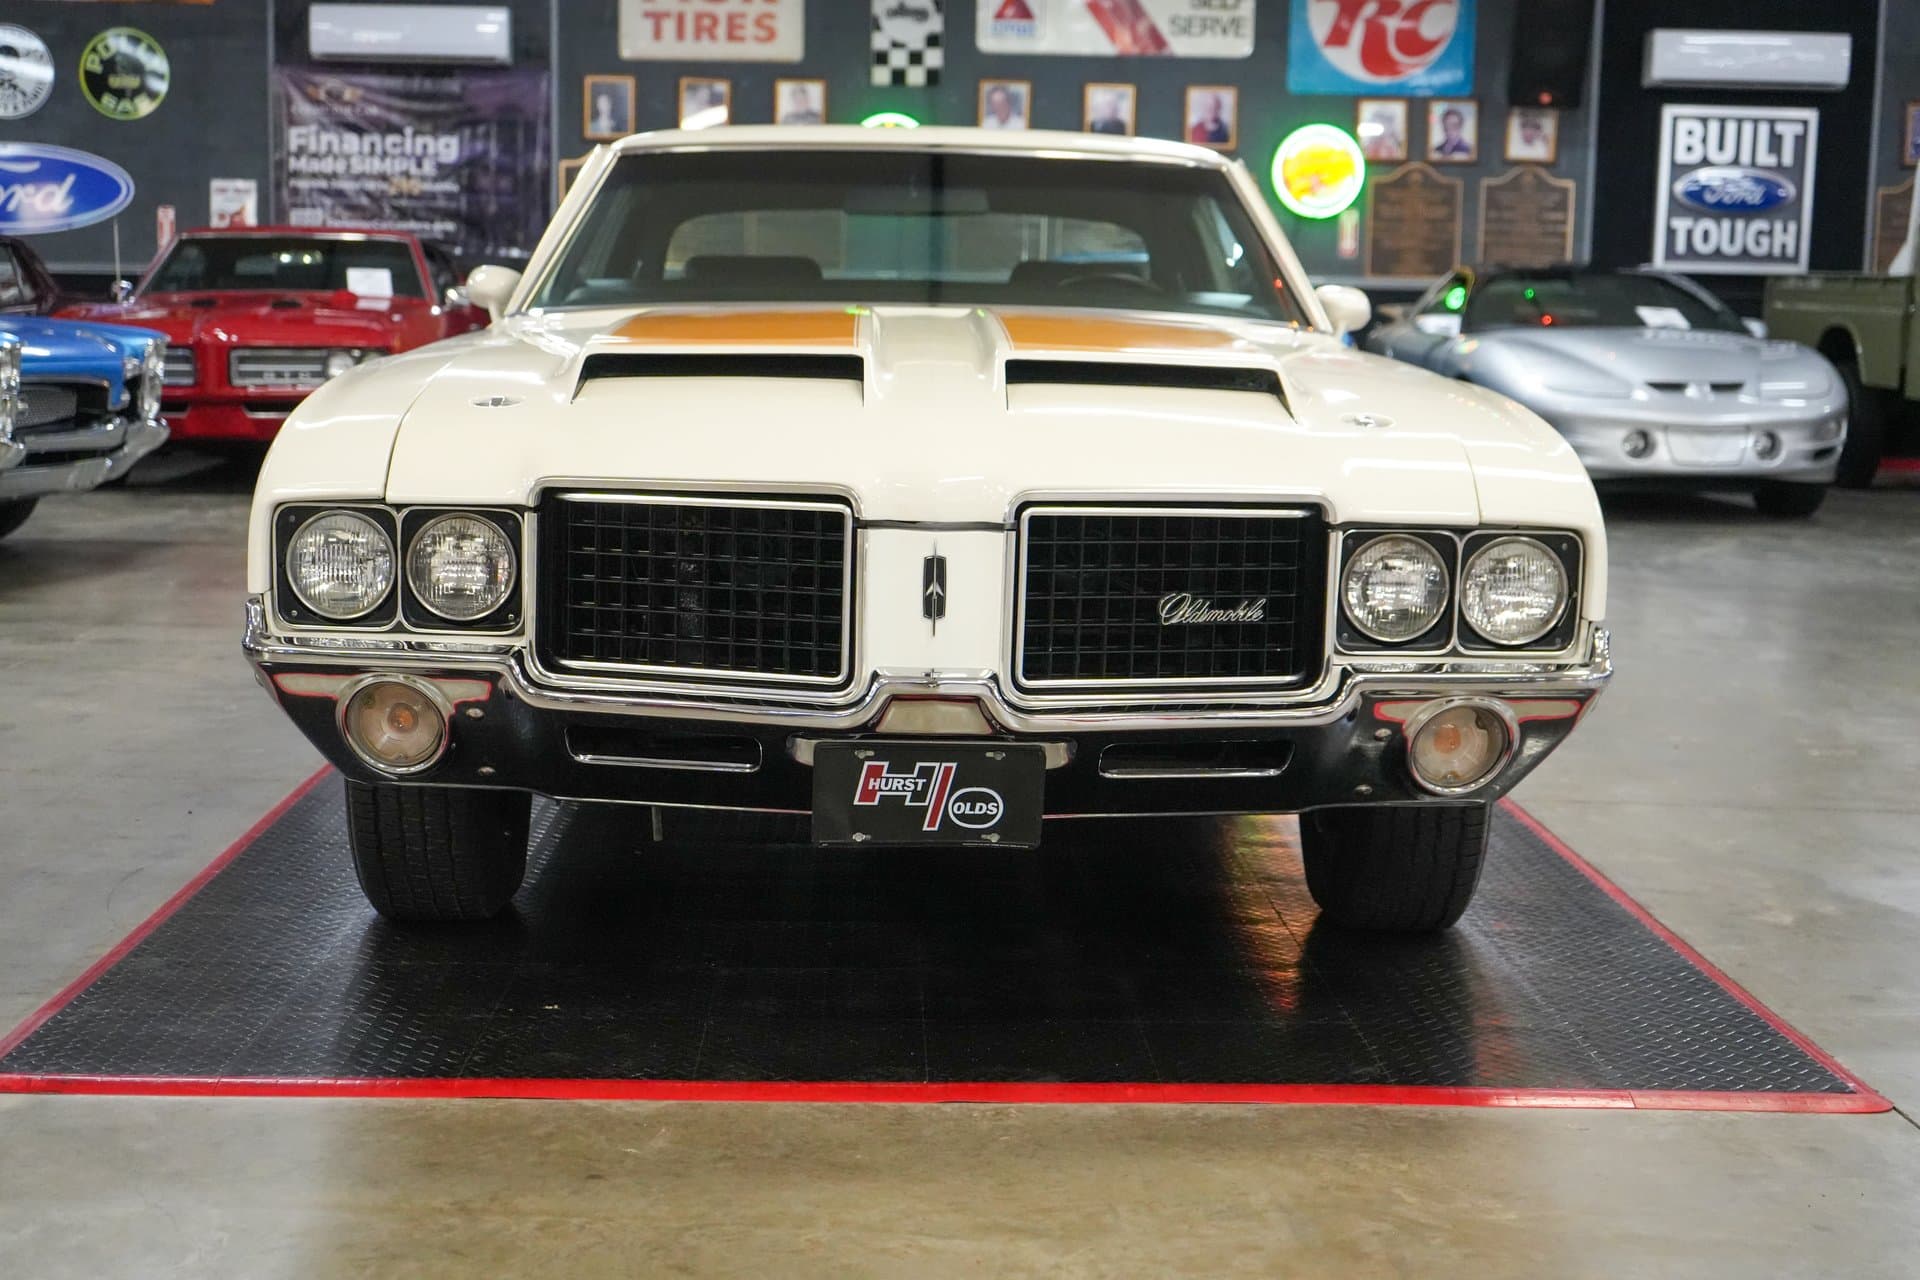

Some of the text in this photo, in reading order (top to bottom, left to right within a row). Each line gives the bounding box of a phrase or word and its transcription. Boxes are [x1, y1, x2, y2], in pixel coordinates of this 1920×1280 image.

[643, 11, 778, 43] TIRES
[1168, 15, 1247, 38] SERVE
[1323, 0, 1453, 76] RC
[288, 126, 460, 163] Financing
[1674, 117, 1804, 167] BUILT
[289, 155, 438, 177] Made SIMPLE
[1669, 216, 1798, 258] TOUGH
[1159, 593, 1267, 625] Oldsmobile
[868, 777, 926, 791] HURST
[953, 801, 998, 815] OLDS
